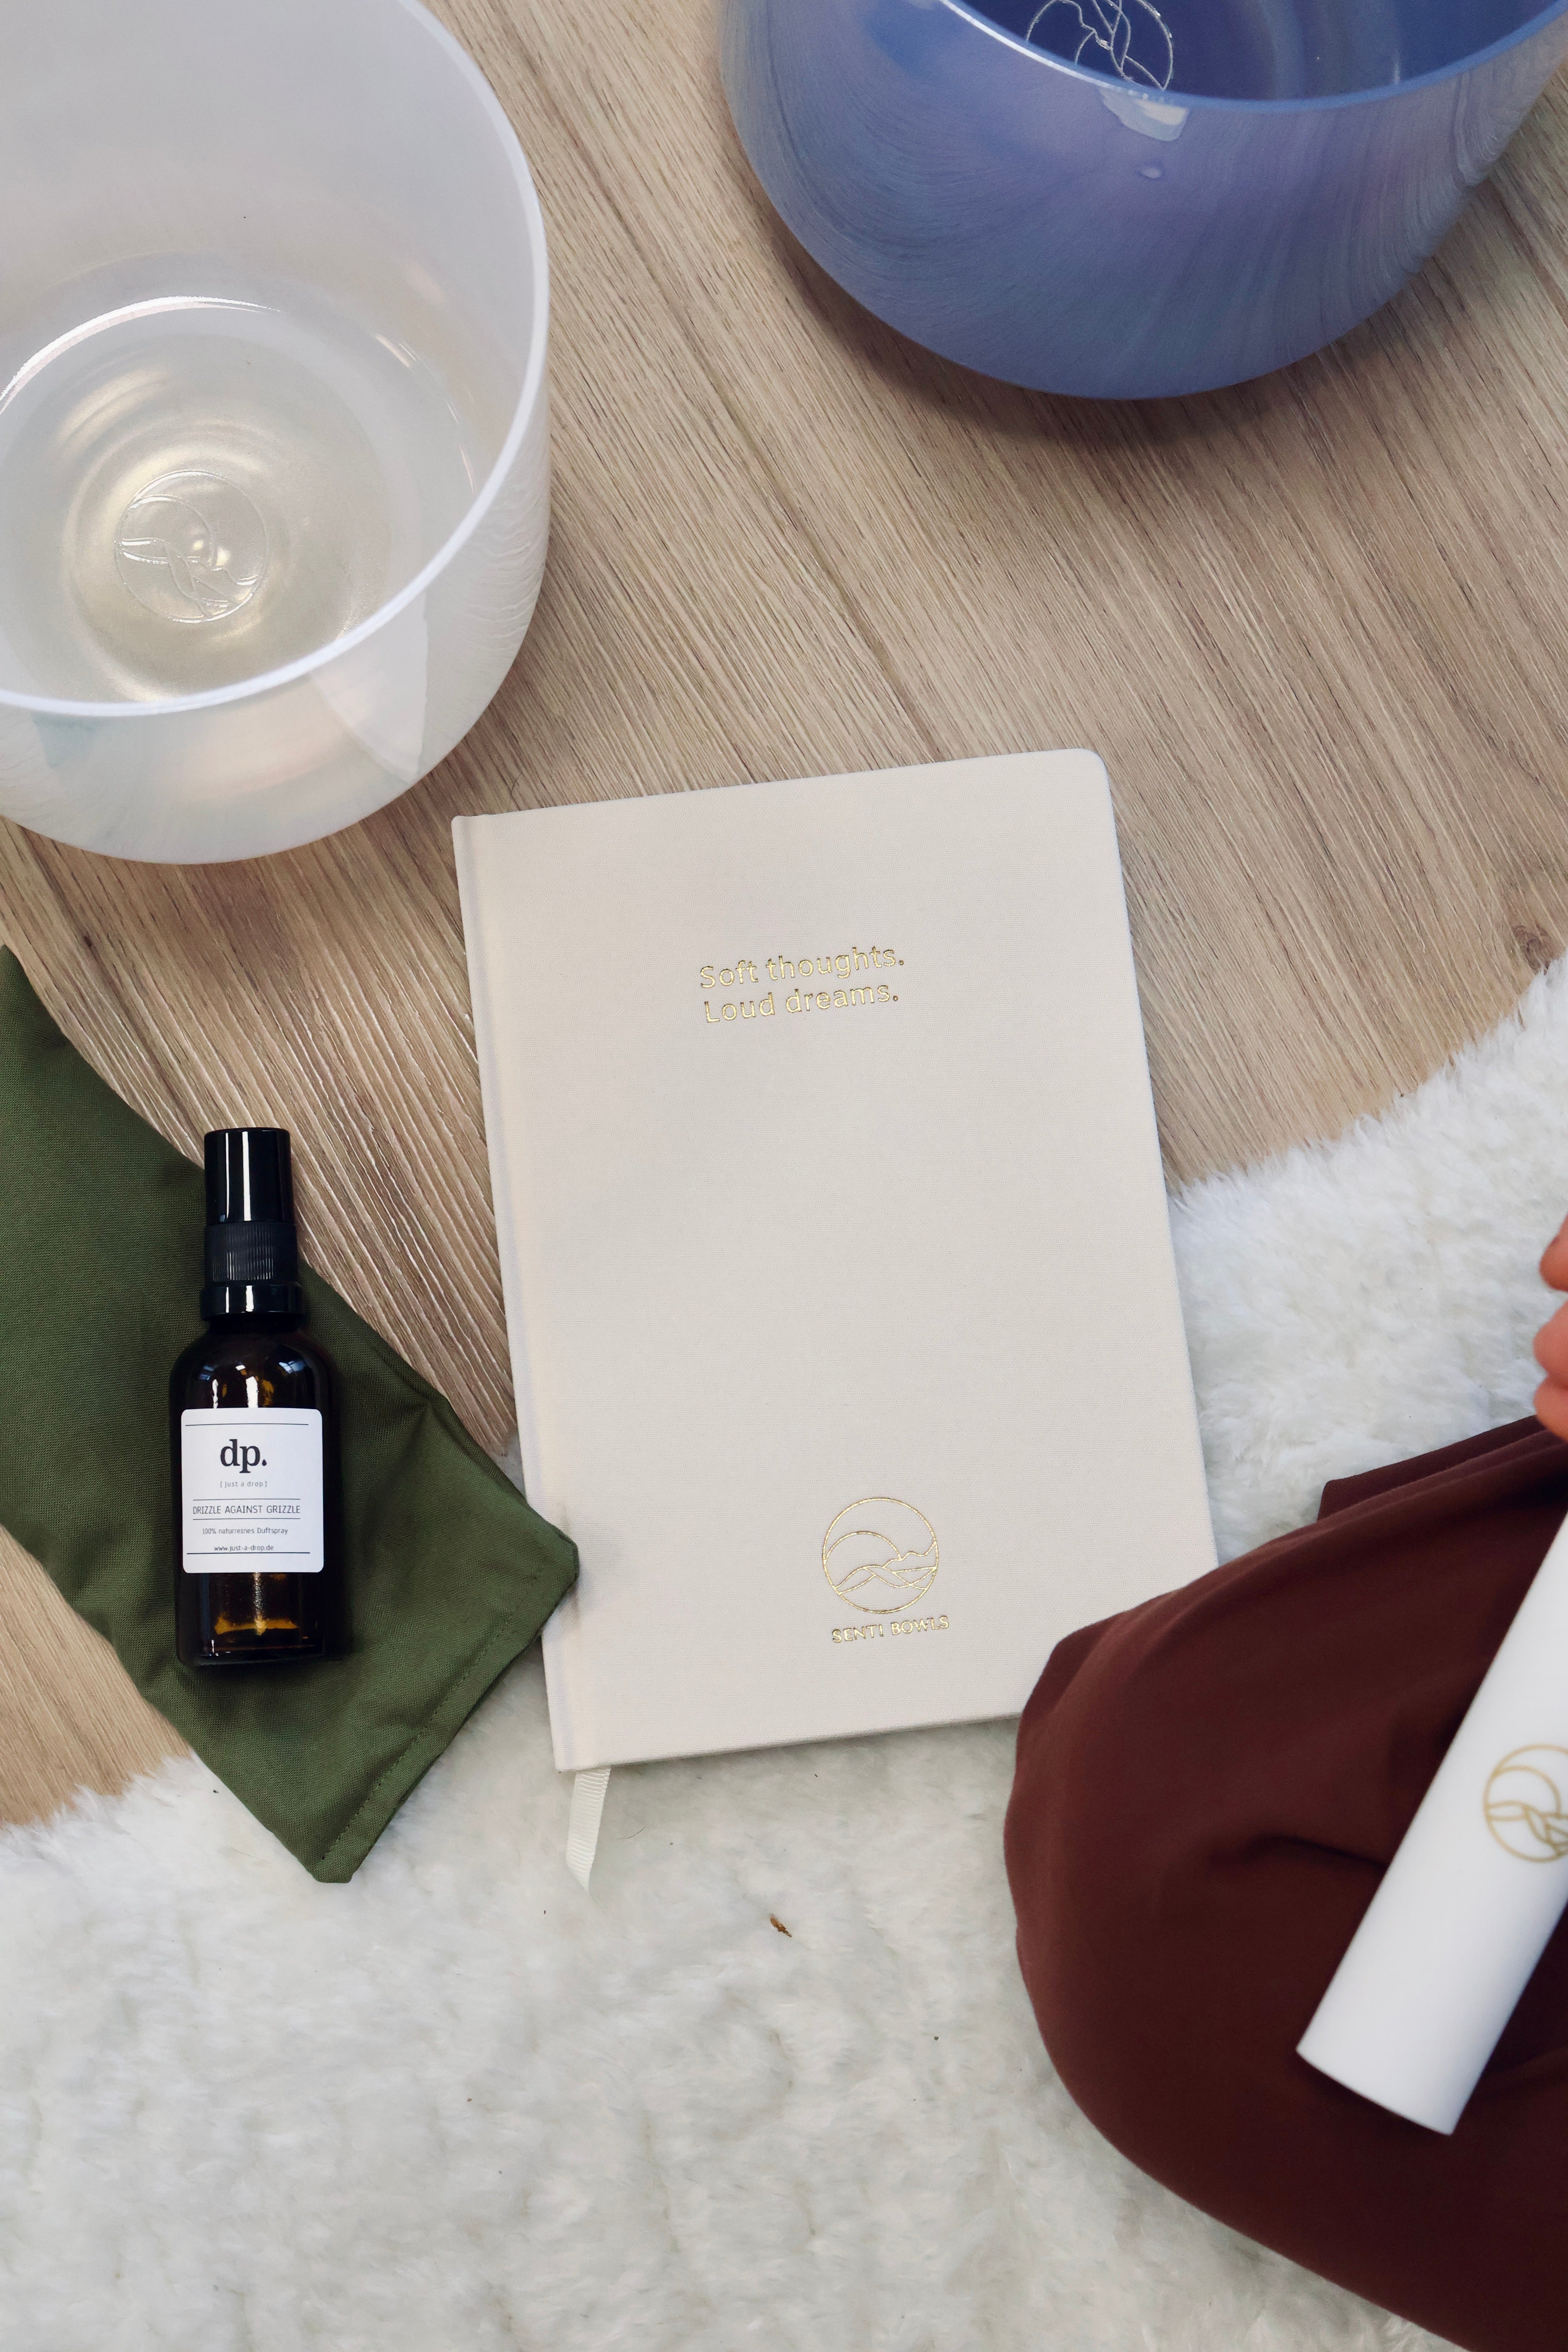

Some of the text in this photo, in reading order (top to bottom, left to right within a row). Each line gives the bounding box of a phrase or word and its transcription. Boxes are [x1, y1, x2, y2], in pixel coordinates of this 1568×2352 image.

[700, 946, 904, 988] Soft thoughts.
[704, 984, 898, 1023] Loud dreams.
[220, 1439, 267, 1473] dp.
[193, 1505, 301, 1514] DRIZZLE AGAINST GRIZZLE
[832, 1615, 949, 1643] SENTI BOWLS
